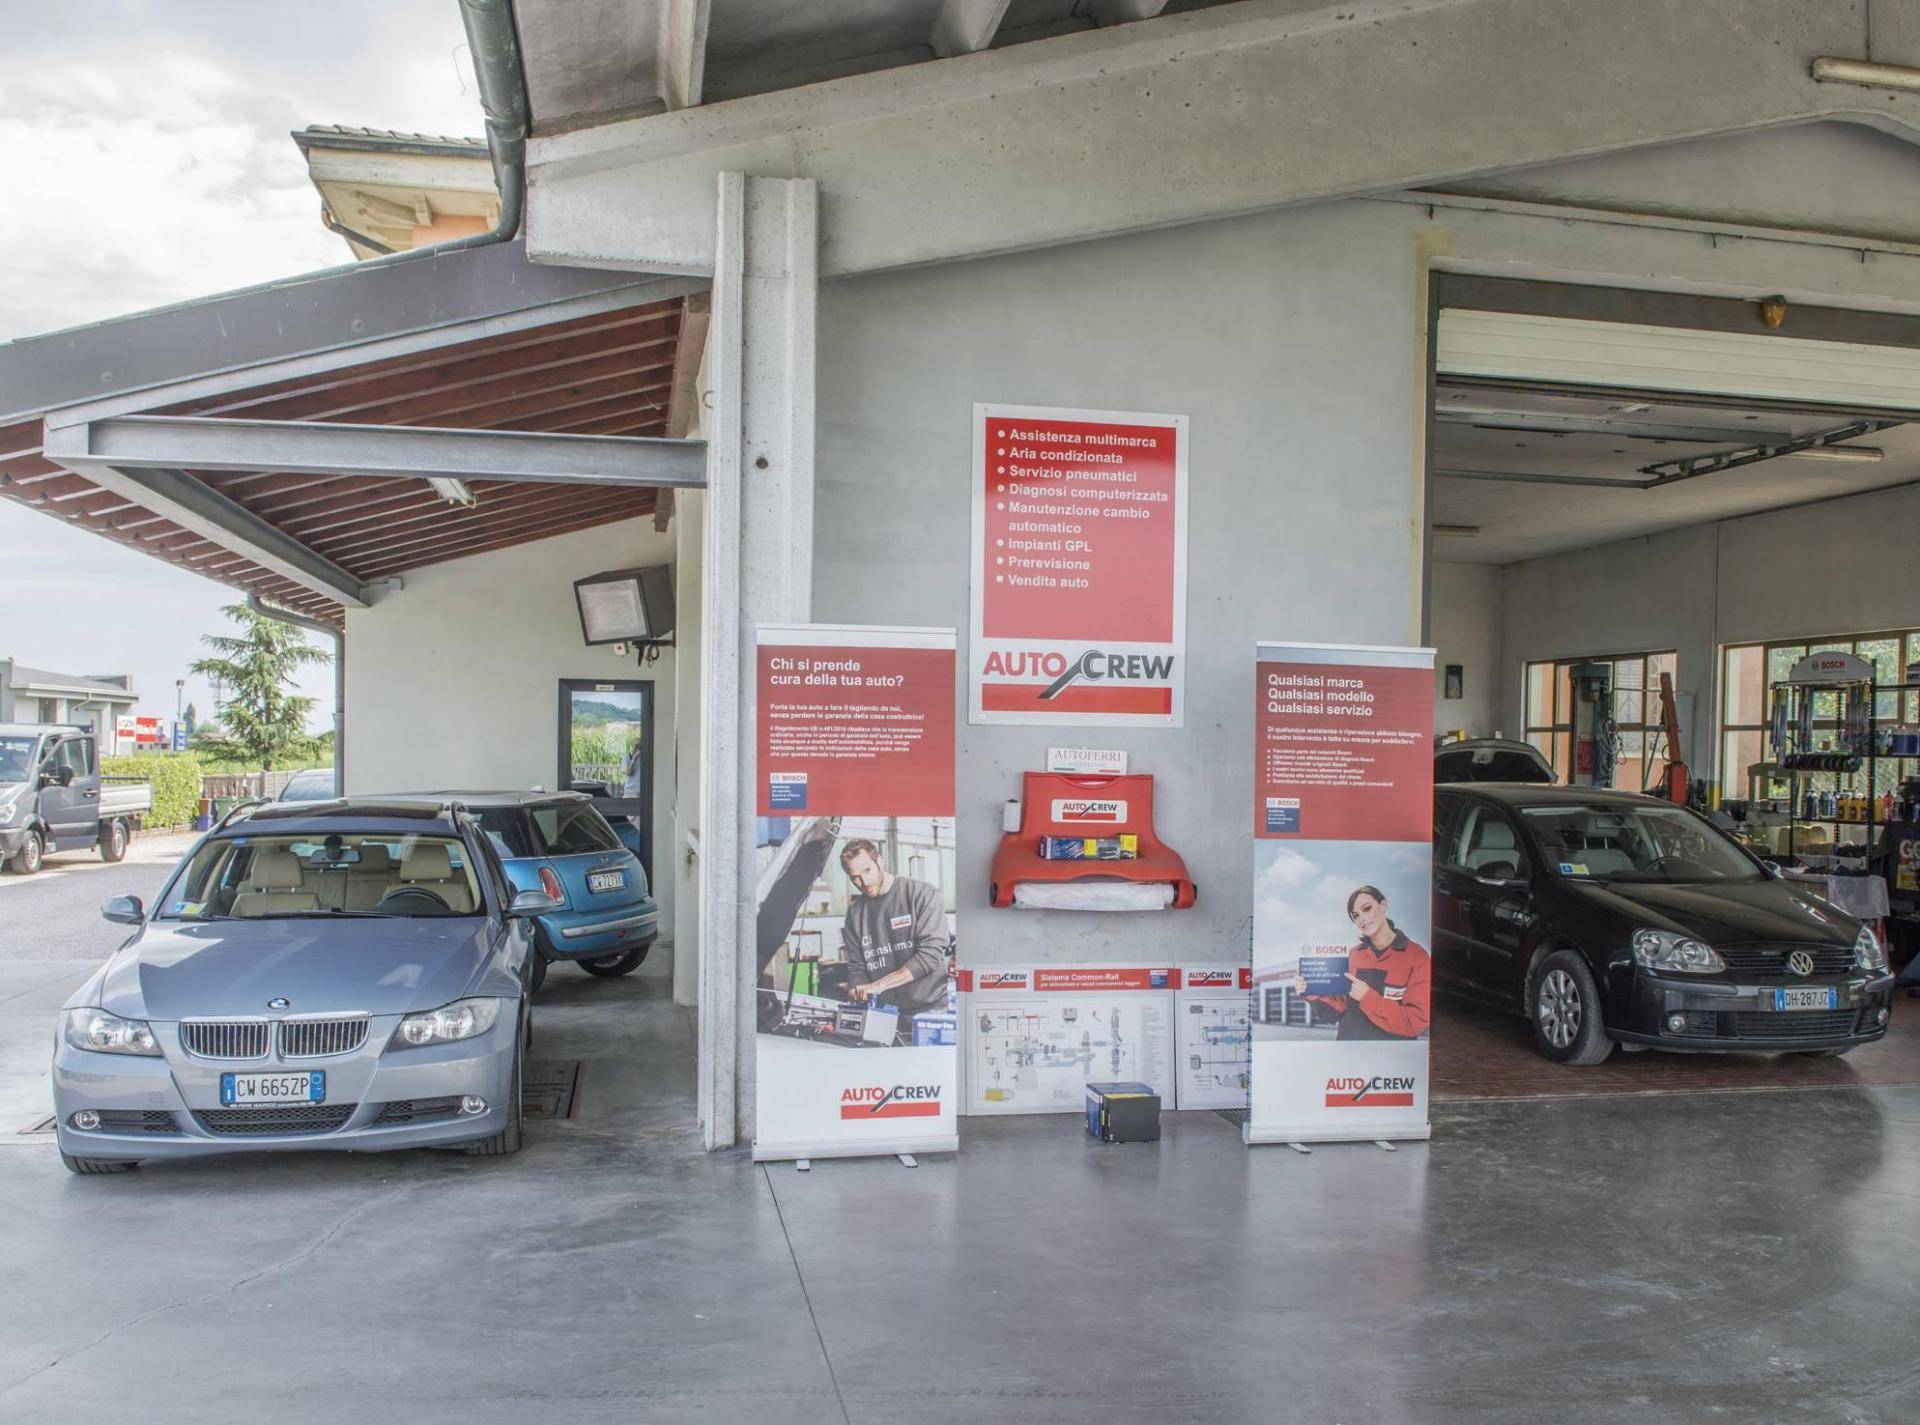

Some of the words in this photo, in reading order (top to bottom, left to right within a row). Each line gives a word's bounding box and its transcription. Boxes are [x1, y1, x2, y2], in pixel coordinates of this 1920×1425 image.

[1009, 428, 1081, 445] Assistenza
[1085, 432, 1156, 448] multimarca
[1009, 447, 1037, 459] Aria
[1040, 449, 1123, 464] condizionata
[1009, 465, 1062, 480] Servizio
[1066, 469, 1137, 484] pneumatici
[1009, 484, 1067, 500] Diagnosi
[1071, 486, 1168, 503] computerizzata
[1009, 502, 1100, 517] Manutenzione
[1103, 505, 1150, 519] cambio
[1009, 521, 1082, 534] automatico
[1009, 538, 1061, 552] Impianti
[1065, 540, 1092, 552] GPL
[1009, 556, 1090, 570] Prerevisione
[1008, 574, 1056, 588] Vendita
[1060, 577, 1088, 589] auto
[771, 658, 793, 670] Chi
[798, 659, 809, 671] si
[814, 659, 860, 673] prende
[982, 651, 1067, 677] AUTO
[1085, 650, 1174, 680] CREW
[1821, 660, 1845, 669] BOSCH
[771, 675, 800, 685] cura
[805, 674, 837, 685] della
[841, 676, 862, 686] tua
[866, 675, 904, 687] auto?
[1268, 674, 1323, 687] Qualsiasi
[1327, 678, 1363, 688] marca
[1268, 688, 1323, 701] Qualsiasi
[1327, 691, 1374, 702] modello
[1268, 702, 1323, 715] Qualsiasi
[1327, 705, 1372, 716] servizio
[1055, 750, 1120, 761] AUTOFERRI
[1062, 803, 1086, 811] AUTO
[1090, 802, 1117, 811] CREW
[1316, 946, 1347, 954] BOSCH
[1786, 992, 1797, 1006] DH
[237, 1080, 255, 1097] CW
[261, 1077, 309, 1096] 665ZP
[1326, 1077, 1365, 1090] AUTO
[1372, 1076, 1414, 1090] CREW
[841, 1087, 885, 1101] AUTO
[893, 1085, 941, 1100] CREW
